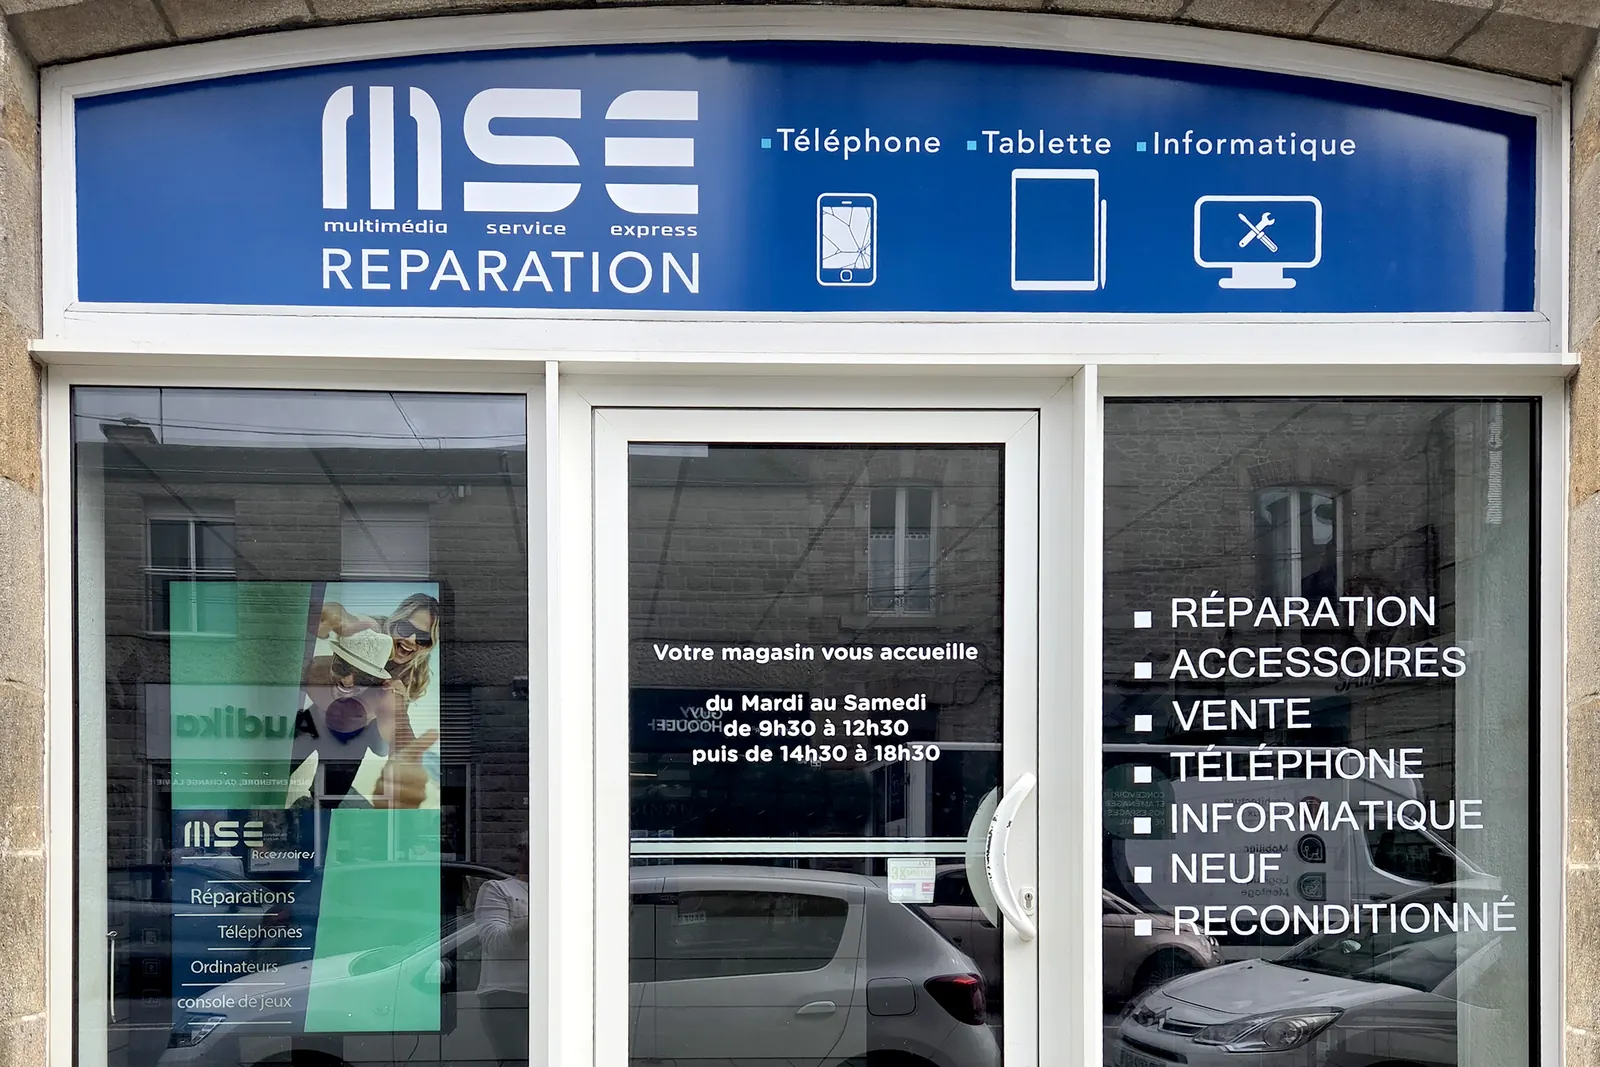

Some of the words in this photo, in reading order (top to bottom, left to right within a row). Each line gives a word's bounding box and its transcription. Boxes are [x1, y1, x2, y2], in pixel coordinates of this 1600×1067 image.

[322, 86, 698, 214] MSE
[777, 128, 940, 160] Téléphone
[982, 130, 1110, 154] Tablette
[1155, 130, 1355, 161] Informatique
[325, 219, 447, 233] multimédia
[487, 222, 565, 234] service
[611, 226, 697, 238] express
[323, 248, 699, 293] REPARATION
[1172, 591, 1434, 627] RÉPARATION
[654, 644, 714, 660] Votre
[722, 644, 814, 663] magasin
[822, 647, 873, 660] vous
[880, 643, 978, 660] accueille
[1170, 647, 1466, 678] ACCESSOIRES
[706, 695, 732, 711] du
[742, 694, 802, 711] Mardi
[811, 698, 836, 711] au
[844, 694, 925, 710] Samedi
[1173, 698, 1311, 730] VENTE
[724, 720, 751, 736] de
[759, 720, 815, 736] 9h30
[824, 719, 835, 736] à
[843, 719, 908, 736] 12h30
[693, 745, 737, 765] puis
[746, 745, 772, 761] de
[780, 745, 847, 761] 14h30
[855, 744, 866, 761] à
[875, 743, 940, 761] 18h30
[1171, 744, 1423, 781] TÉLÉPHONE
[1172, 800, 1483, 833] INFORMATIQUE
[184, 820, 263, 848] MSE
[252, 849, 316, 861] Accessoires
[1172, 854, 1281, 883] NEUF
[191, 888, 296, 907] Réparations
[1175, 895, 1516, 935] RECONDITIONNÉ
[218, 925, 302, 941] Téléphones
[191, 960, 278, 975] Ordinateurs
[178, 994, 236, 1008] console
[239, 994, 257, 1007] de
[260, 994, 292, 1010] jeux
